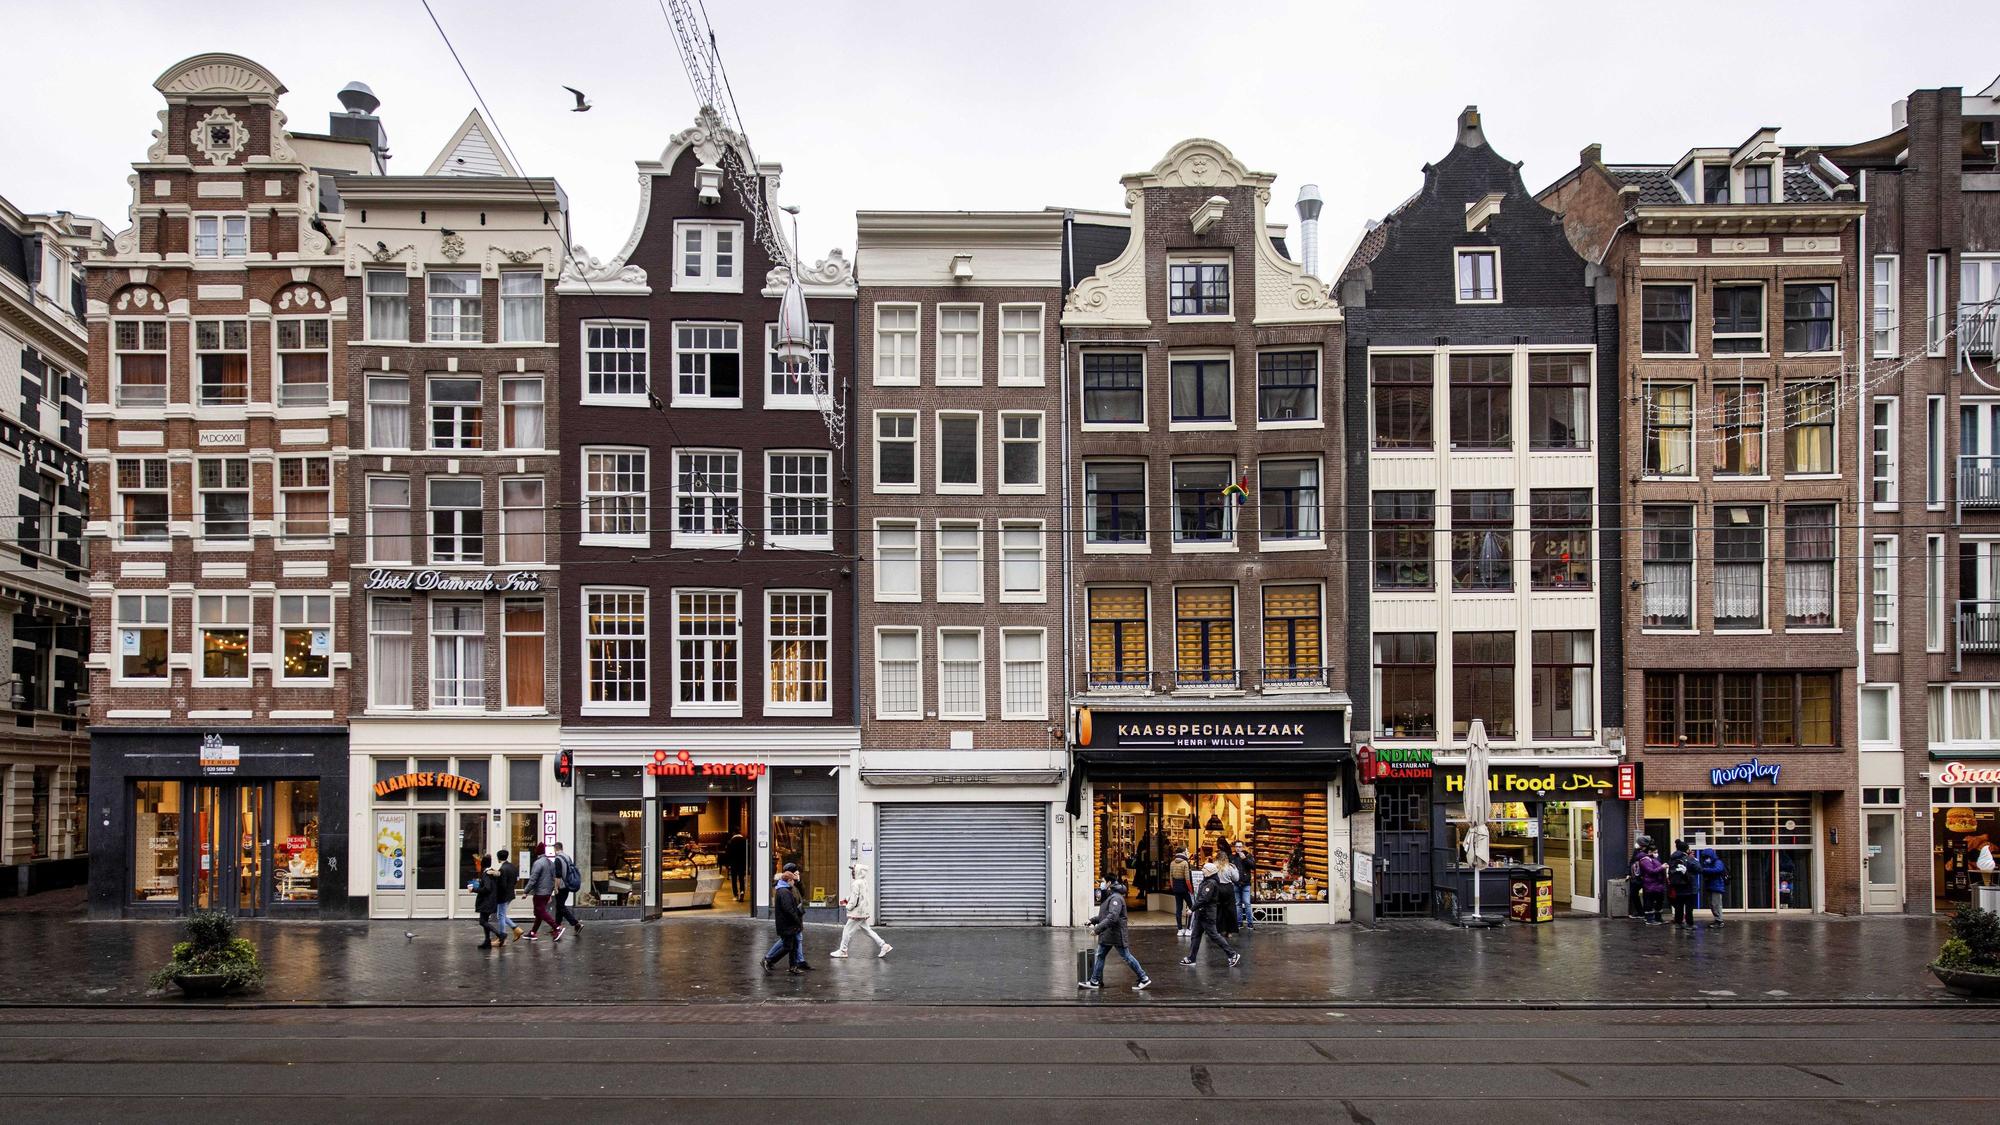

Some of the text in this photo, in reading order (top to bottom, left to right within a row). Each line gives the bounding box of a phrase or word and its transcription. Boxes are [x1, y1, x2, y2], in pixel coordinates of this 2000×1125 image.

[414, 570, 495, 591] Damrak
[496, 572, 540, 591] Inn
[1118, 724, 1305, 736] KAASSPECIAALZAAK
[646, 750, 695, 776] simit
[1376, 749, 1433, 762] INDIAN
[1391, 769, 1433, 778] GANDHI
[1712, 758, 1781, 785] novoplay
[373, 772, 481, 797] VLAAMSE FRITES
[1506, 774, 1556, 791] Food
[619, 810, 643, 818] PASTRY
